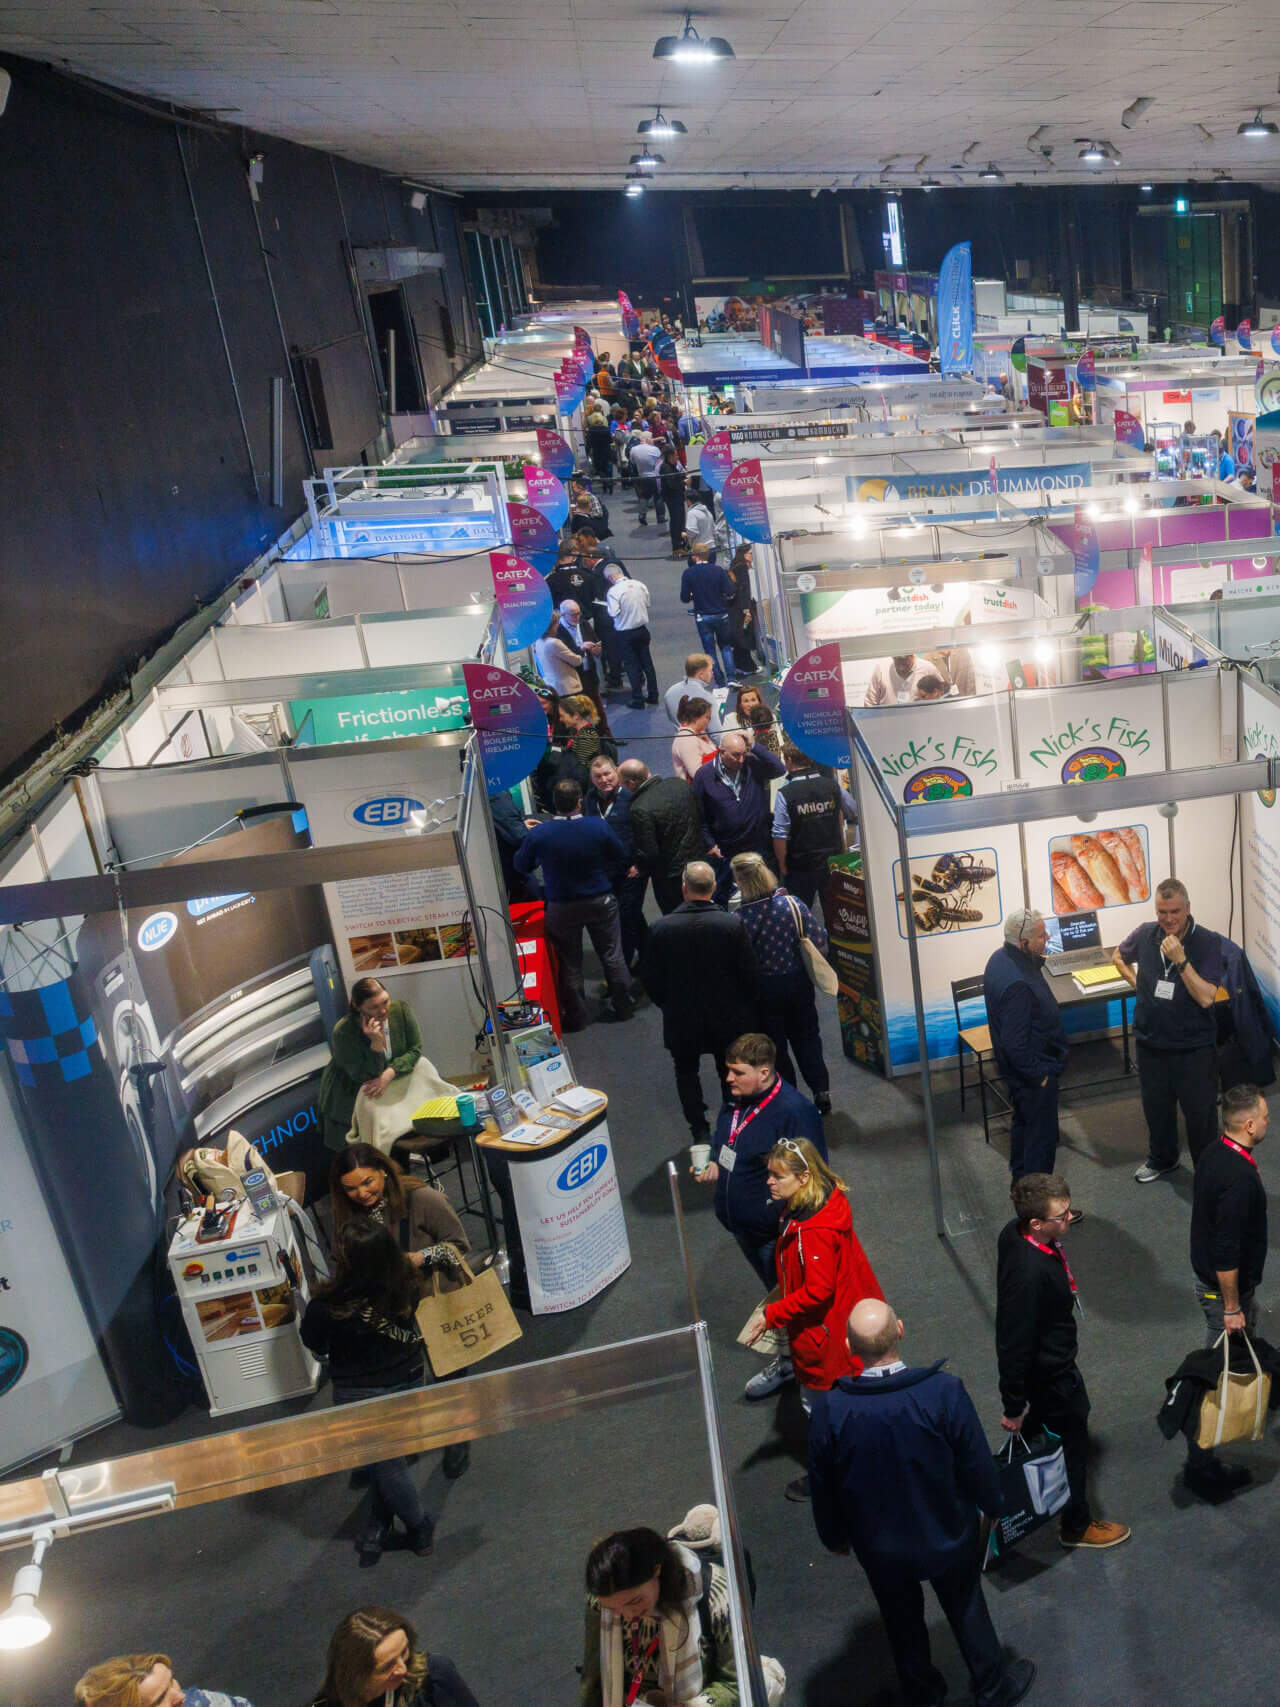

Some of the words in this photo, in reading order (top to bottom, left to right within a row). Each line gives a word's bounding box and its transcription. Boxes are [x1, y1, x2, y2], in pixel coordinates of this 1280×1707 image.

[706, 443, 729, 451] CATEX
[529, 477, 555, 487] CATEX
[730, 474, 761, 486] CATEX
[907, 483, 964, 500] BRIAN
[969, 474, 1084, 497] DRUMMOND
[512, 516, 543, 527] CATEX
[496, 568, 533, 580] CATEX
[875, 604, 913, 616] partner
[914, 600, 944, 612] today!
[983, 594, 1018, 609] trustdish
[794, 666, 840, 682] CATEX
[472, 682, 521, 700] CATEX
[337, 703, 463, 728] Frictionless
[486, 744, 520, 752] IRELAND
[1029, 718, 1102, 768] Nick's
[1107, 717, 1151, 757] Fish
[838, 755, 851, 765] K2
[951, 736, 999, 776] Fish
[488, 776, 501, 787] K1
[364, 801, 409, 822] EBI
[344, 922, 374, 930] SWITCH
[387, 916, 421, 925] ELECTRIC
[566, 1147, 599, 1187] EBI
[540, 1216, 554, 1225] LET
[556, 1211, 566, 1220] US
[567, 1203, 582, 1216] HELP
[559, 1198, 601, 1228] SUSTAINABILITY
[544, 1300, 576, 1312] SWITCH
[441, 1302, 494, 1334] BAKER
[459, 1325, 493, 1352] 51
